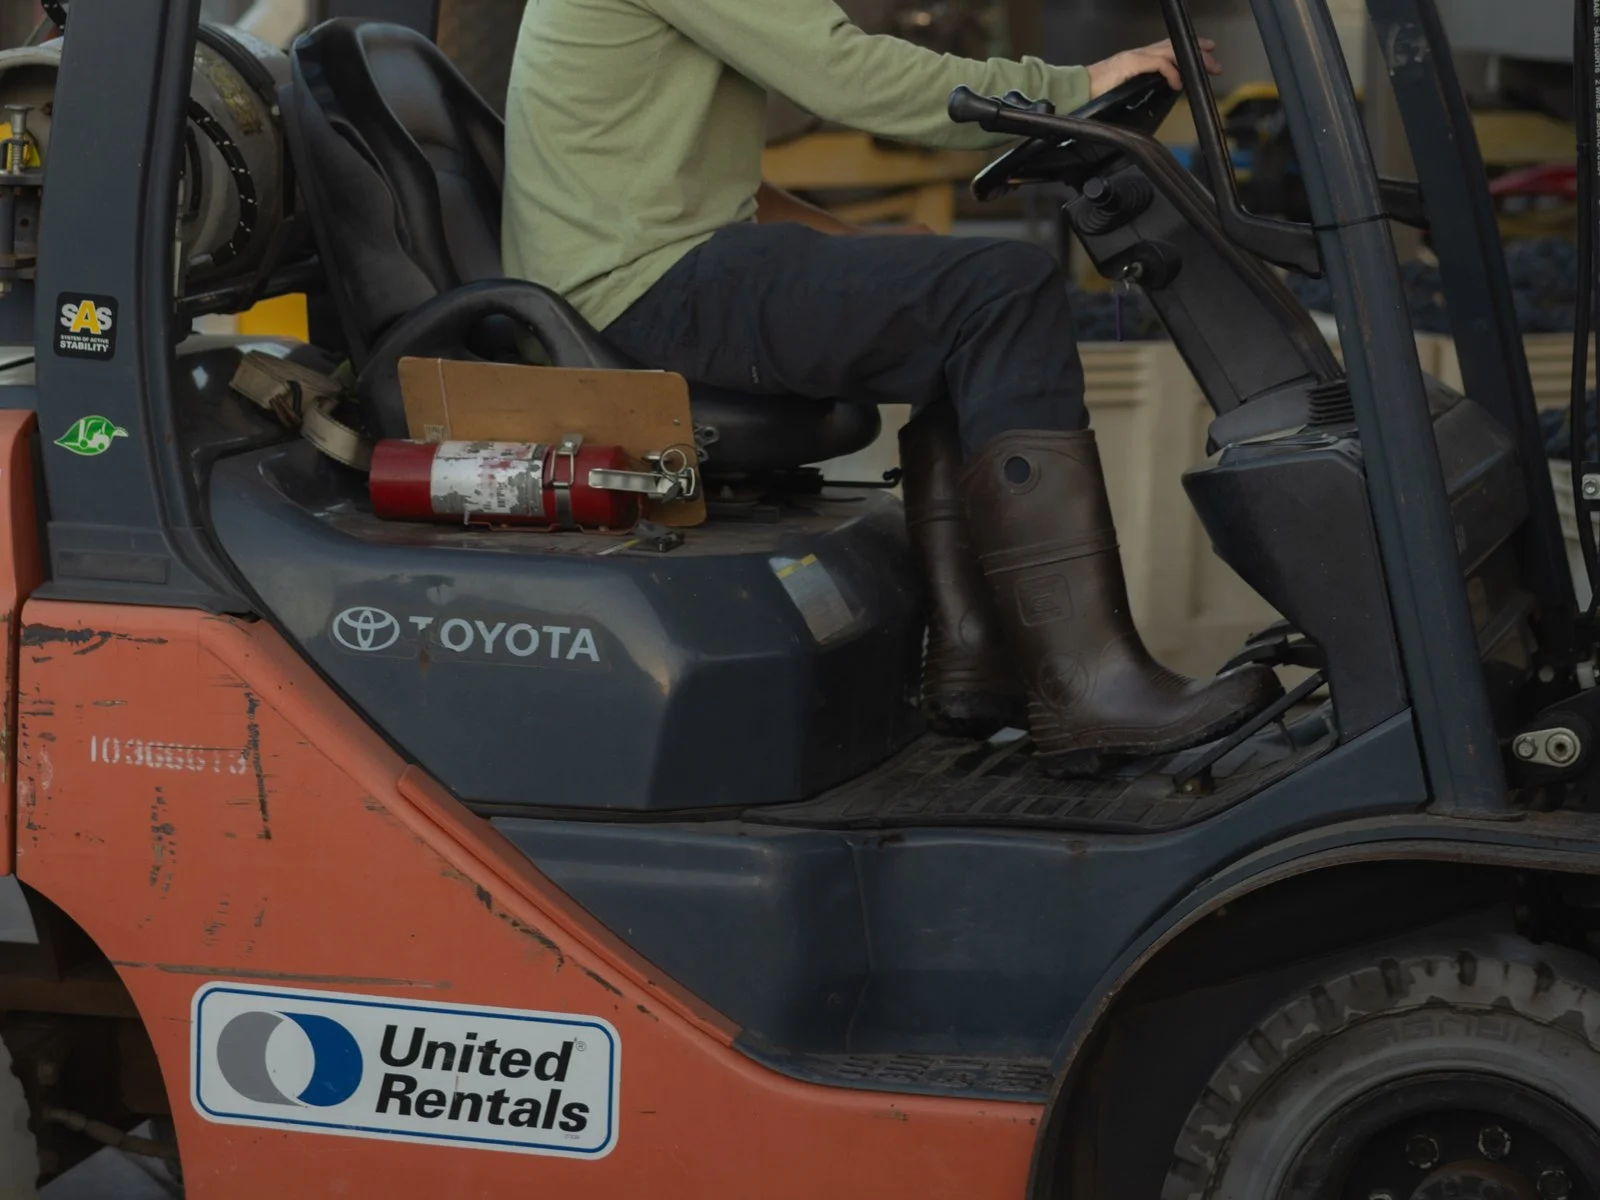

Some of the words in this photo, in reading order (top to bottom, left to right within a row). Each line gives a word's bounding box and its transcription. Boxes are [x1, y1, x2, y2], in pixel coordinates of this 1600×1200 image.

[60, 300, 113, 335] SAS
[60, 340, 109, 352] STABILITY
[375, 1073, 590, 1133] Rentals
